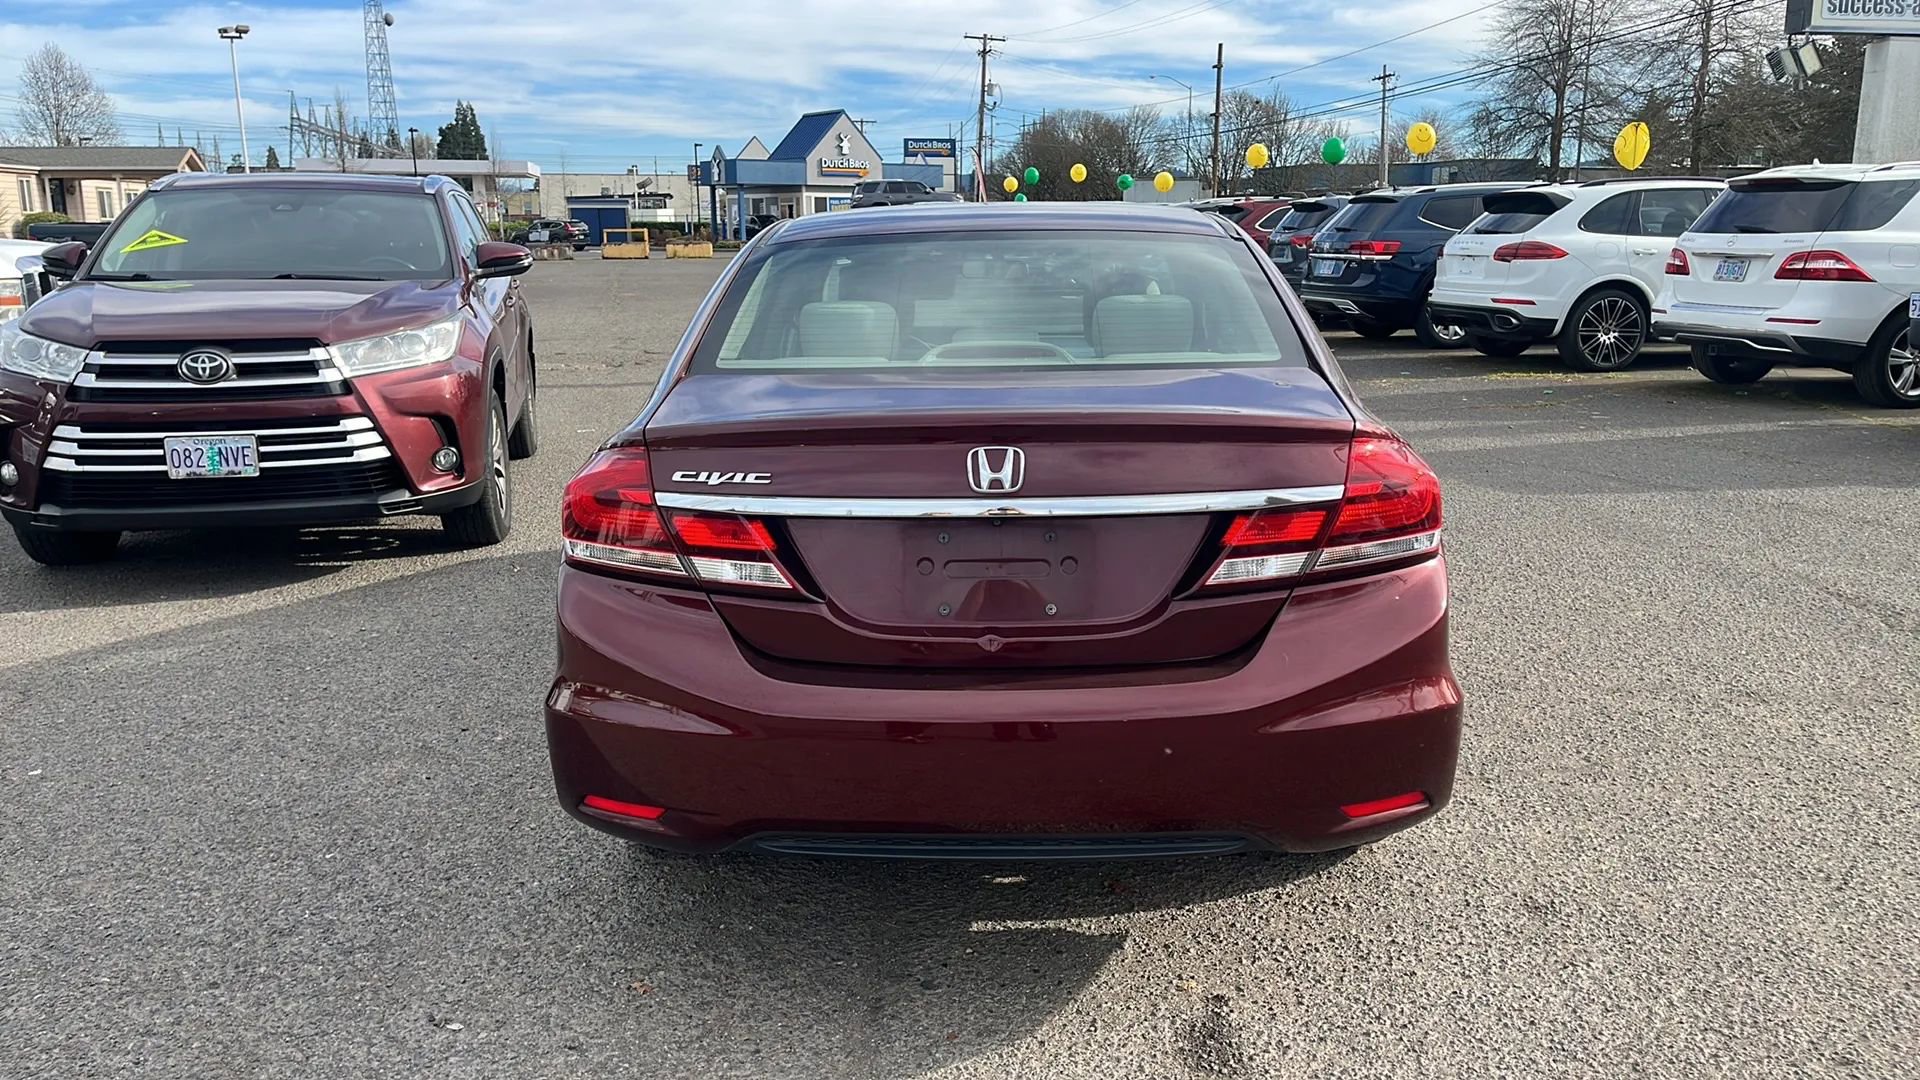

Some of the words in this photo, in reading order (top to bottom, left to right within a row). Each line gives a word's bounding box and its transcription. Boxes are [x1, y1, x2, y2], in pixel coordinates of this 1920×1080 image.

[908, 140, 932, 149] DUTCH
[932, 140, 952, 149] BROS
[821, 157, 849, 169] DUTCH
[849, 159, 870, 169] BROS
[193, 438, 227, 446] Oregon
[170, 447, 206, 469] 082
[218, 445, 254, 467] NVE
[671, 471, 772, 486] CIVIC
